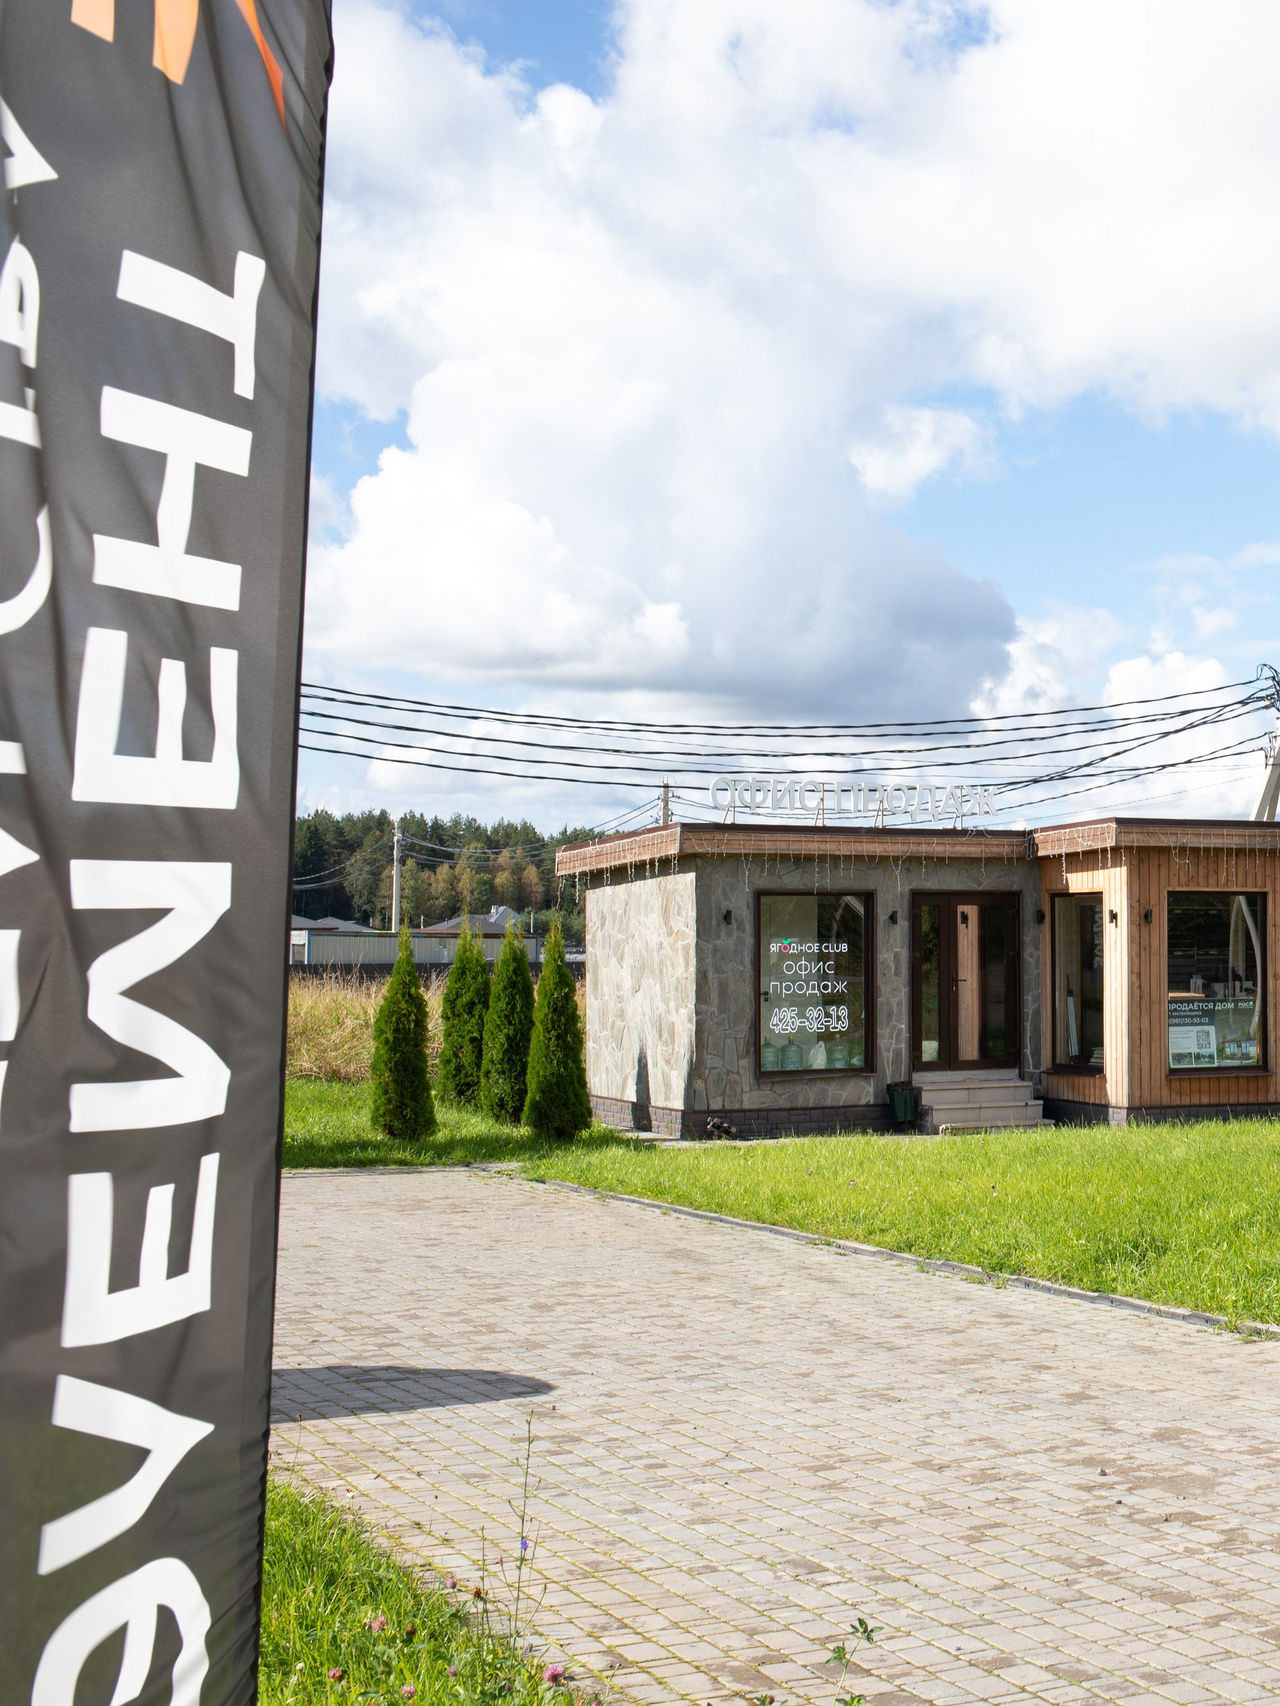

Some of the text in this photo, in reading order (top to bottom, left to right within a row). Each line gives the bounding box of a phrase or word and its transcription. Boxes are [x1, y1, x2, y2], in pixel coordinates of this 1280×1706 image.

[709, 776, 999, 821] ОФИС ПРОДАЖ
[770, 942, 848, 954] ЯГОДНОЕ CLUB
[783, 956, 834, 979] офис
[770, 981, 848, 998] продаж
[1215, 1002, 1234, 1011] ДОМ
[770, 1006, 849, 1033] 425-32-13
